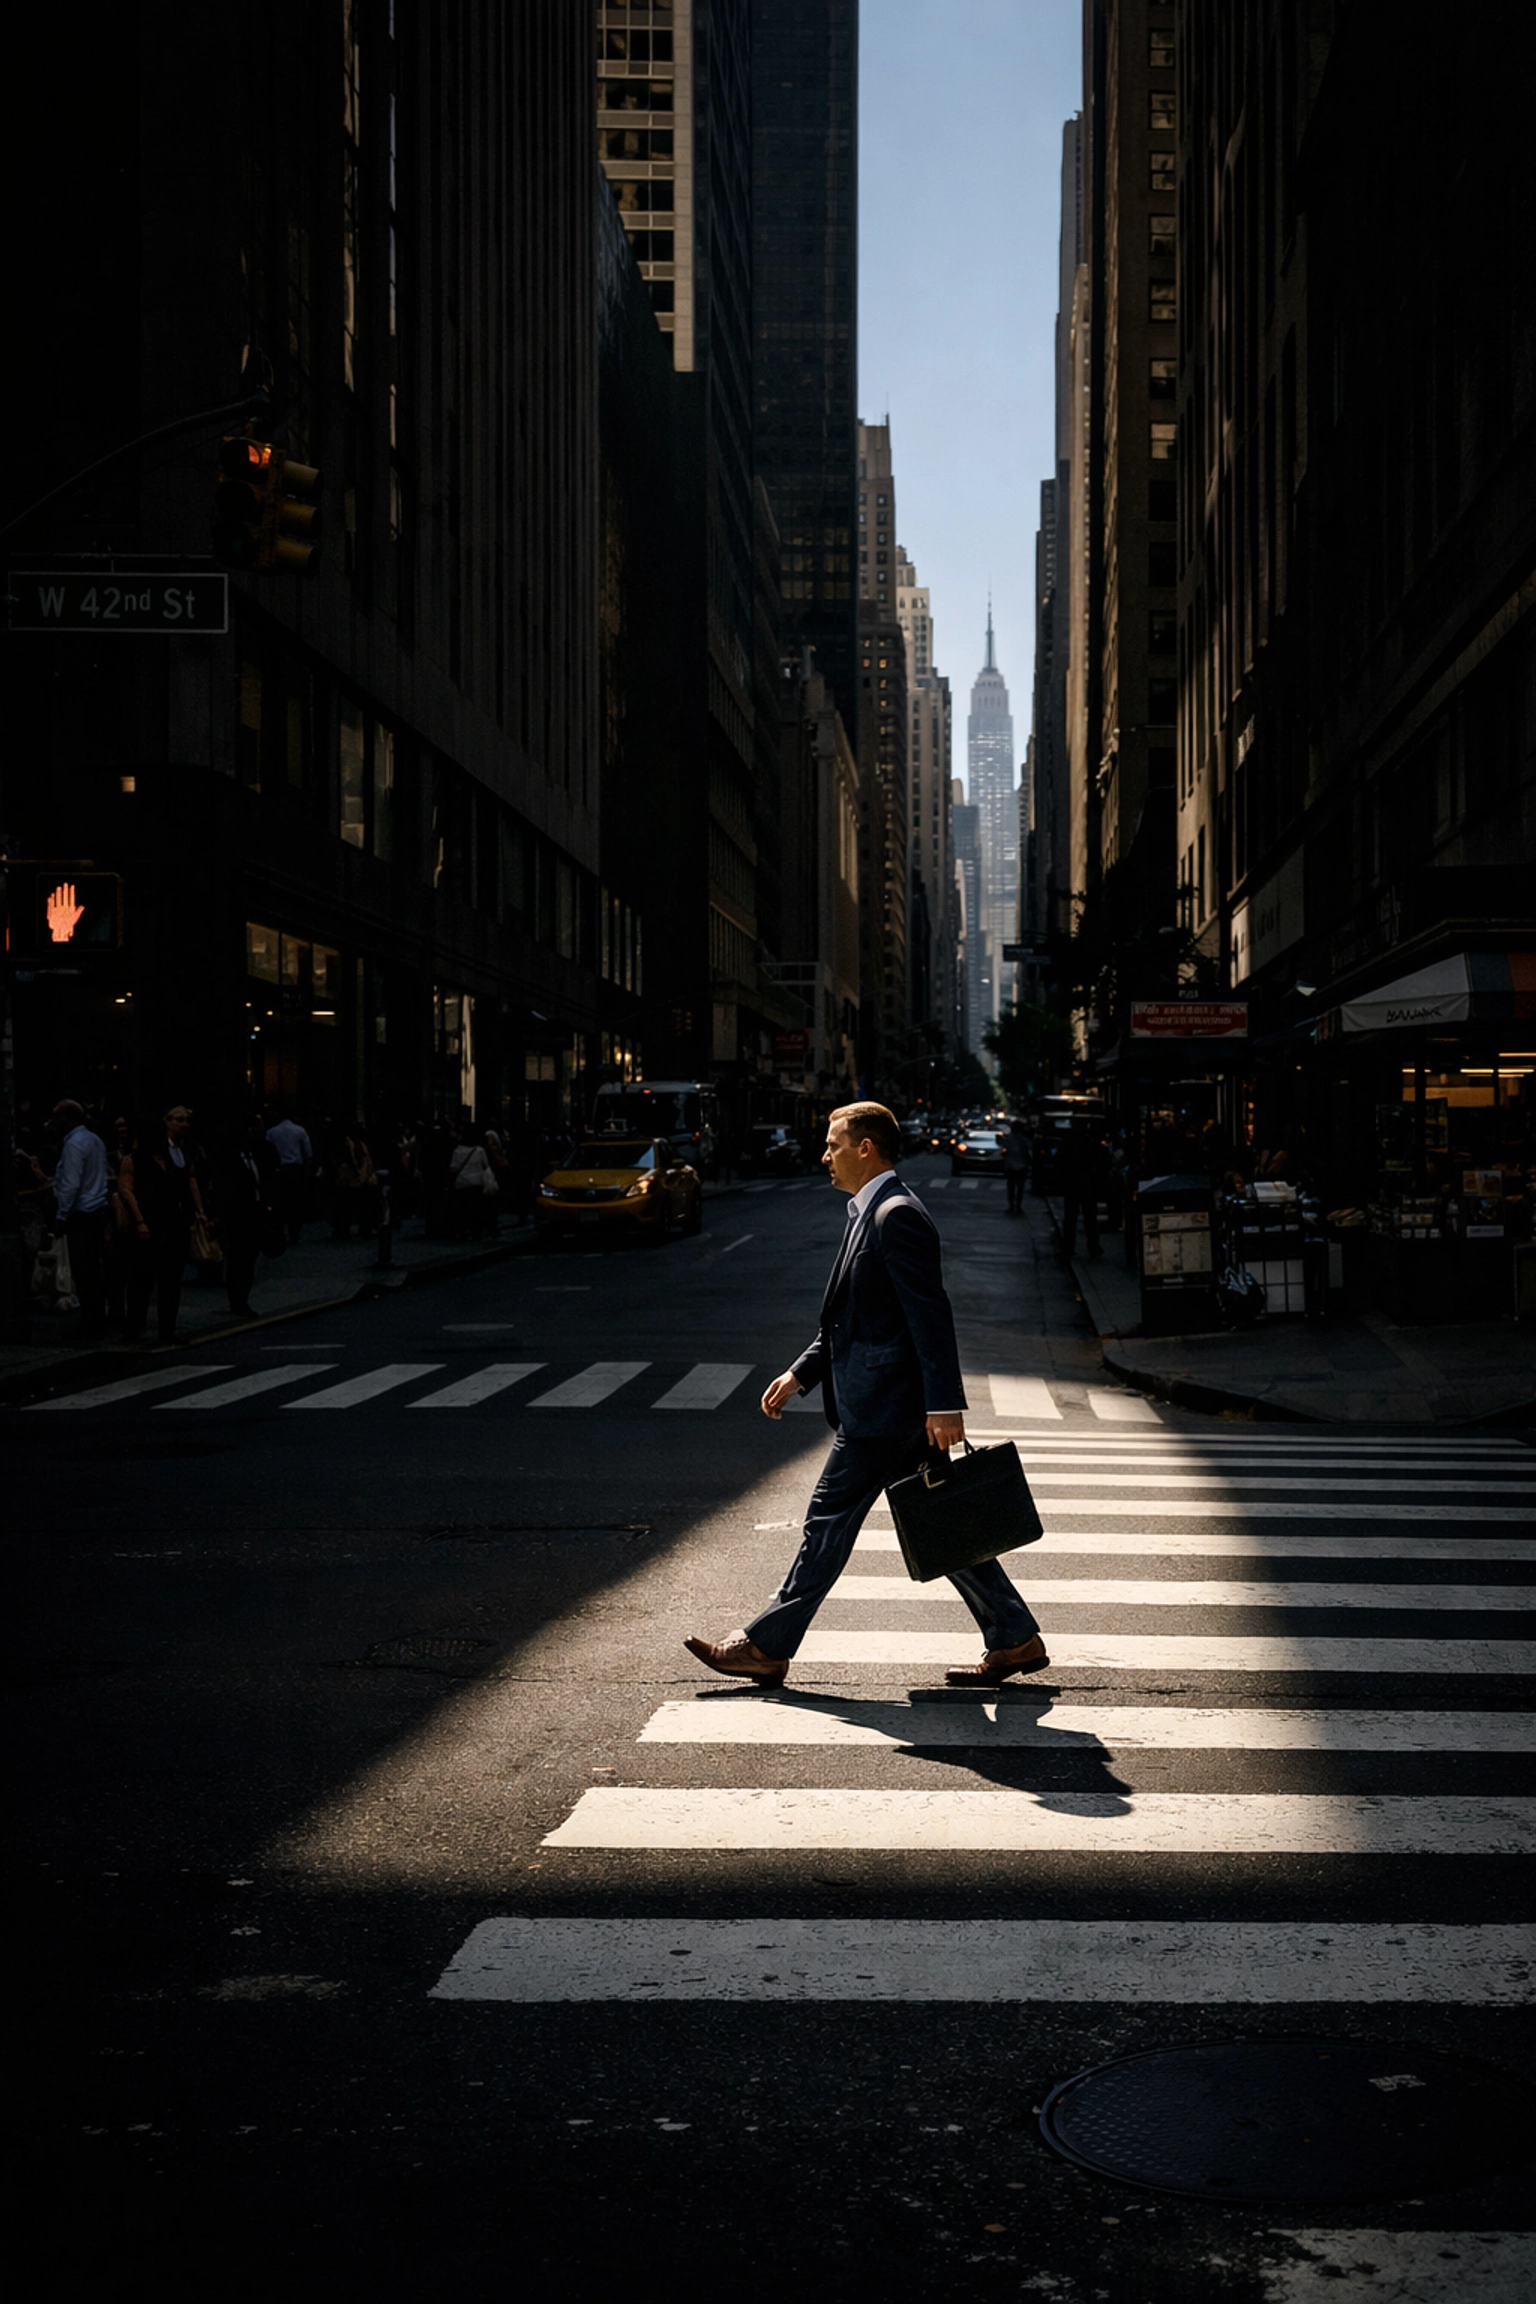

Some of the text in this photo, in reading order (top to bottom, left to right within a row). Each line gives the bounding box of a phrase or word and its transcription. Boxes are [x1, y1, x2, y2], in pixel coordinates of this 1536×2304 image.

[37, 586, 196, 620] W 42nd St
